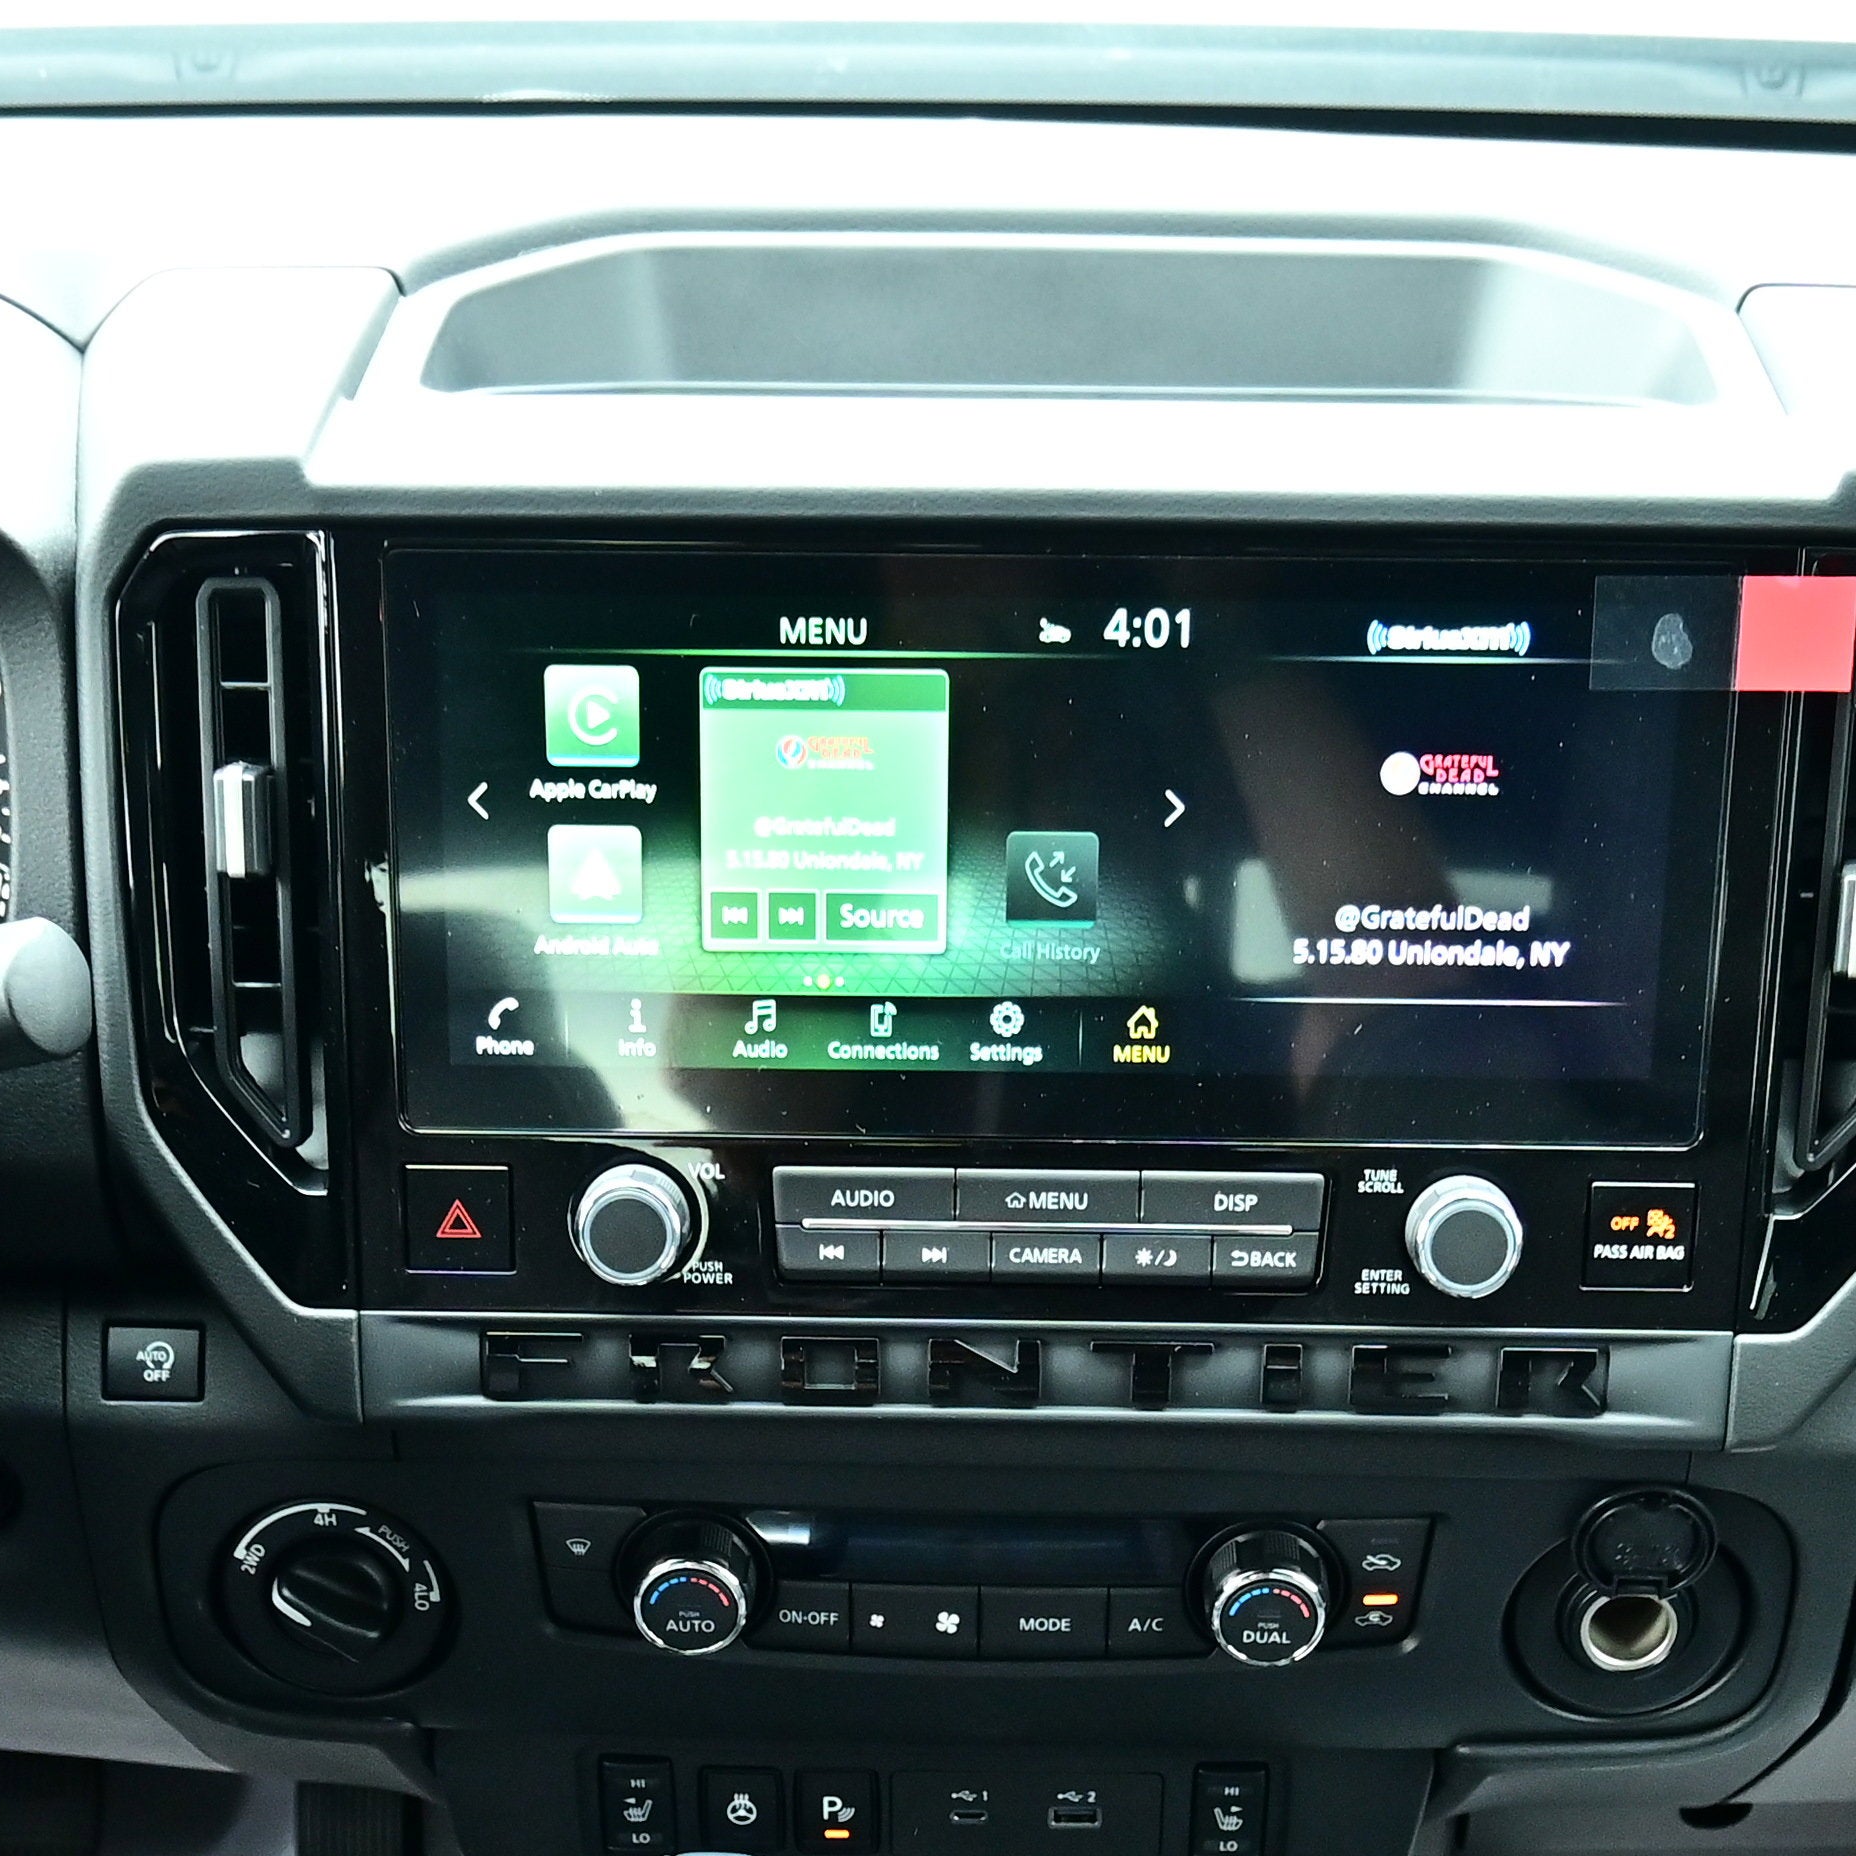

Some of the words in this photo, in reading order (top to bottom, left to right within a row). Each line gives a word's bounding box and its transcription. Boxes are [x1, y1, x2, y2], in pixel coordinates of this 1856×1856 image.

[779, 617, 868, 646] MENU
[1103, 606, 1192, 649] 4:01
[1419, 753, 1499, 777] GRATEFUL
[1435, 767, 1485, 783] DEAD
[529, 777, 586, 803] Apple
[587, 778, 658, 804] CarPlay
[839, 903, 925, 930] Source
[1334, 903, 1531, 934] @GratefulDead
[999, 942, 1033, 960] Call
[1036, 942, 1101, 965] History
[1292, 938, 1383, 968] 5.15.80
[1386, 938, 1525, 972] Uniondale,
[1529, 940, 1572, 968] NY
[475, 1036, 535, 1058] Phone
[617, 1037, 657, 1058] Info
[732, 1037, 789, 1060] Audio
[826, 1039, 940, 1063] Connections
[969, 1041, 1043, 1066] Settings
[1112, 1044, 1171, 1064] MENU
[687, 1161, 726, 1182] VOL
[1363, 1168, 1398, 1182] TUNE
[1357, 1180, 1405, 1195] SCROLL
[830, 1189, 896, 1209] AUDIO
[1028, 1191, 1089, 1212] MENU
[1213, 1192, 1259, 1213] DISP
[1610, 1215, 1640, 1231] OFF
[1008, 1246, 1083, 1267] CAMERA
[1250, 1248, 1298, 1269] BACK
[1593, 1243, 1628, 1259] PASS
[1629, 1244, 1655, 1260] AIR
[1655, 1244, 1685, 1261] BAG
[691, 1260, 725, 1275] PUSH
[1360, 1268, 1403, 1284] ENTER
[682, 1271, 734, 1286] POWER
[1353, 1281, 1411, 1297] SETTING
[135, 1350, 168, 1362] AUTO
[143, 1369, 172, 1382] OFF
[483, 1330, 1612, 1411] FRONTIER
[313, 1513, 338, 1527] 4H
[377, 1524, 410, 1553] PUSH
[240, 1543, 266, 1575] 2WD
[413, 1582, 430, 1612] 4LO
[665, 1618, 716, 1634] AUTO
[1018, 1617, 1072, 1633] MODE
[1127, 1616, 1164, 1634] A/C
[1242, 1629, 1291, 1646] DUAL
[1223, 1786, 1240, 1796] HI
[632, 1832, 651, 1845] LO
[1218, 1840, 1239, 1853] LO
